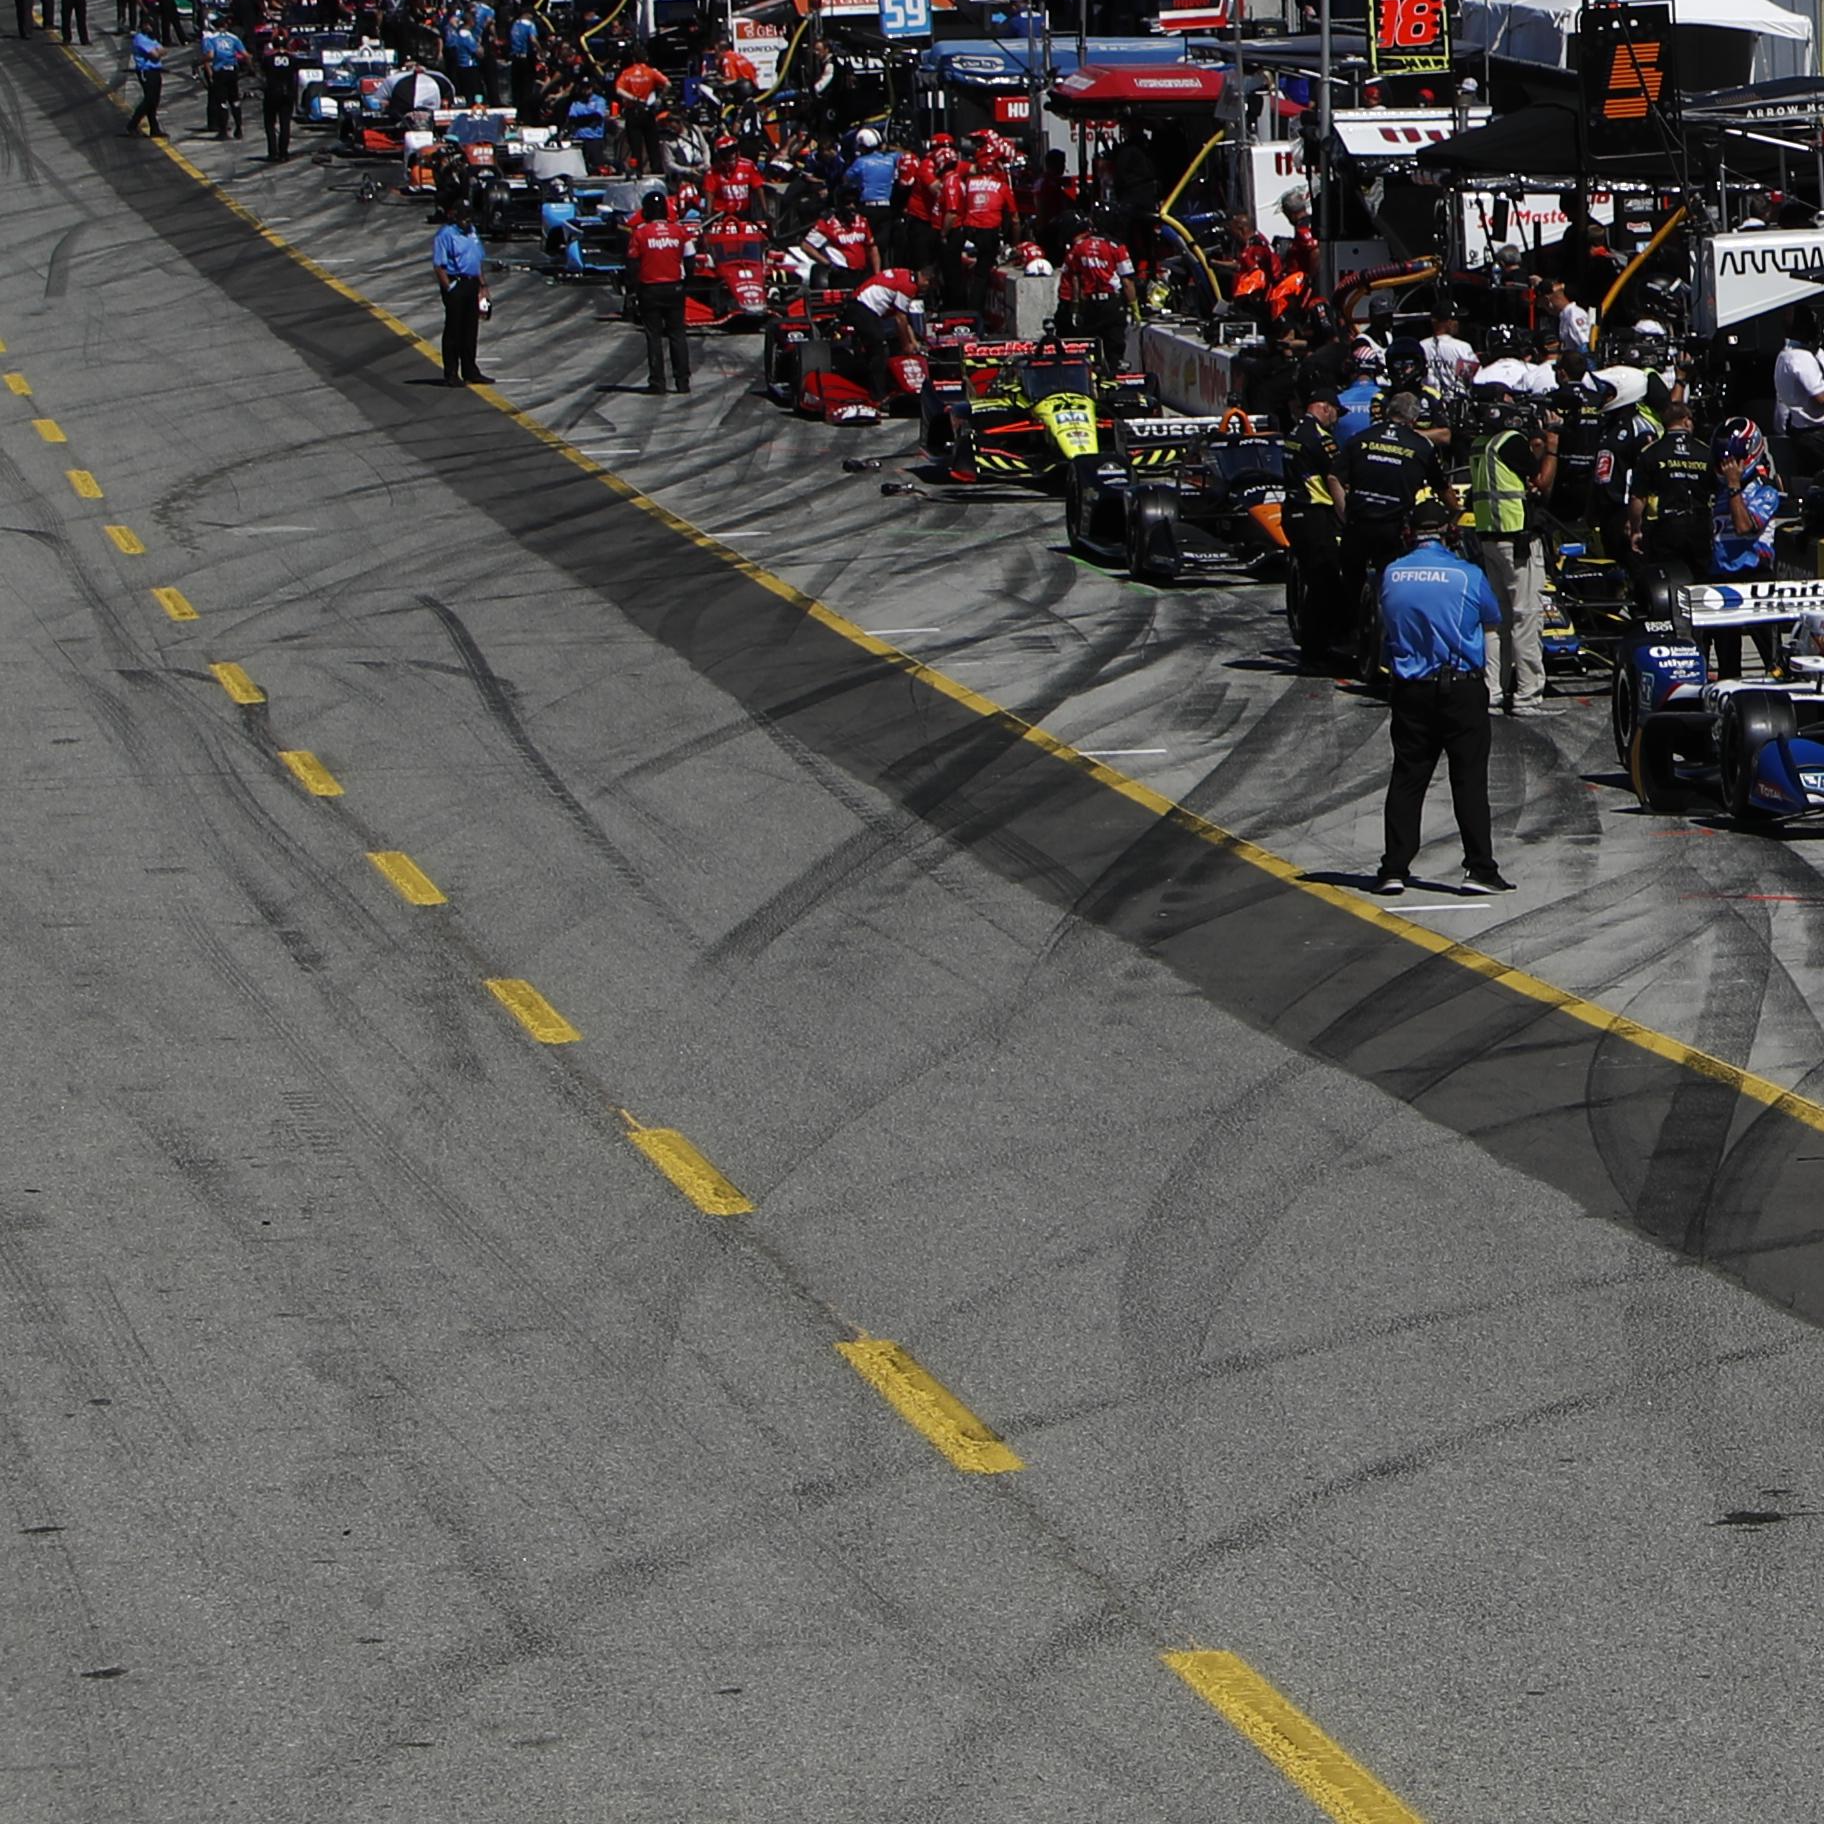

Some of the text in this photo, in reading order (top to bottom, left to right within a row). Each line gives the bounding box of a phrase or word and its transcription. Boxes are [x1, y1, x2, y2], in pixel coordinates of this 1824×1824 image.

[1603, 42, 1664, 120] 5
[1746, 104, 1799, 119] ARROW
[647, 236, 681, 250] HyVee
[1391, 570, 1450, 585] OFFICIAL
